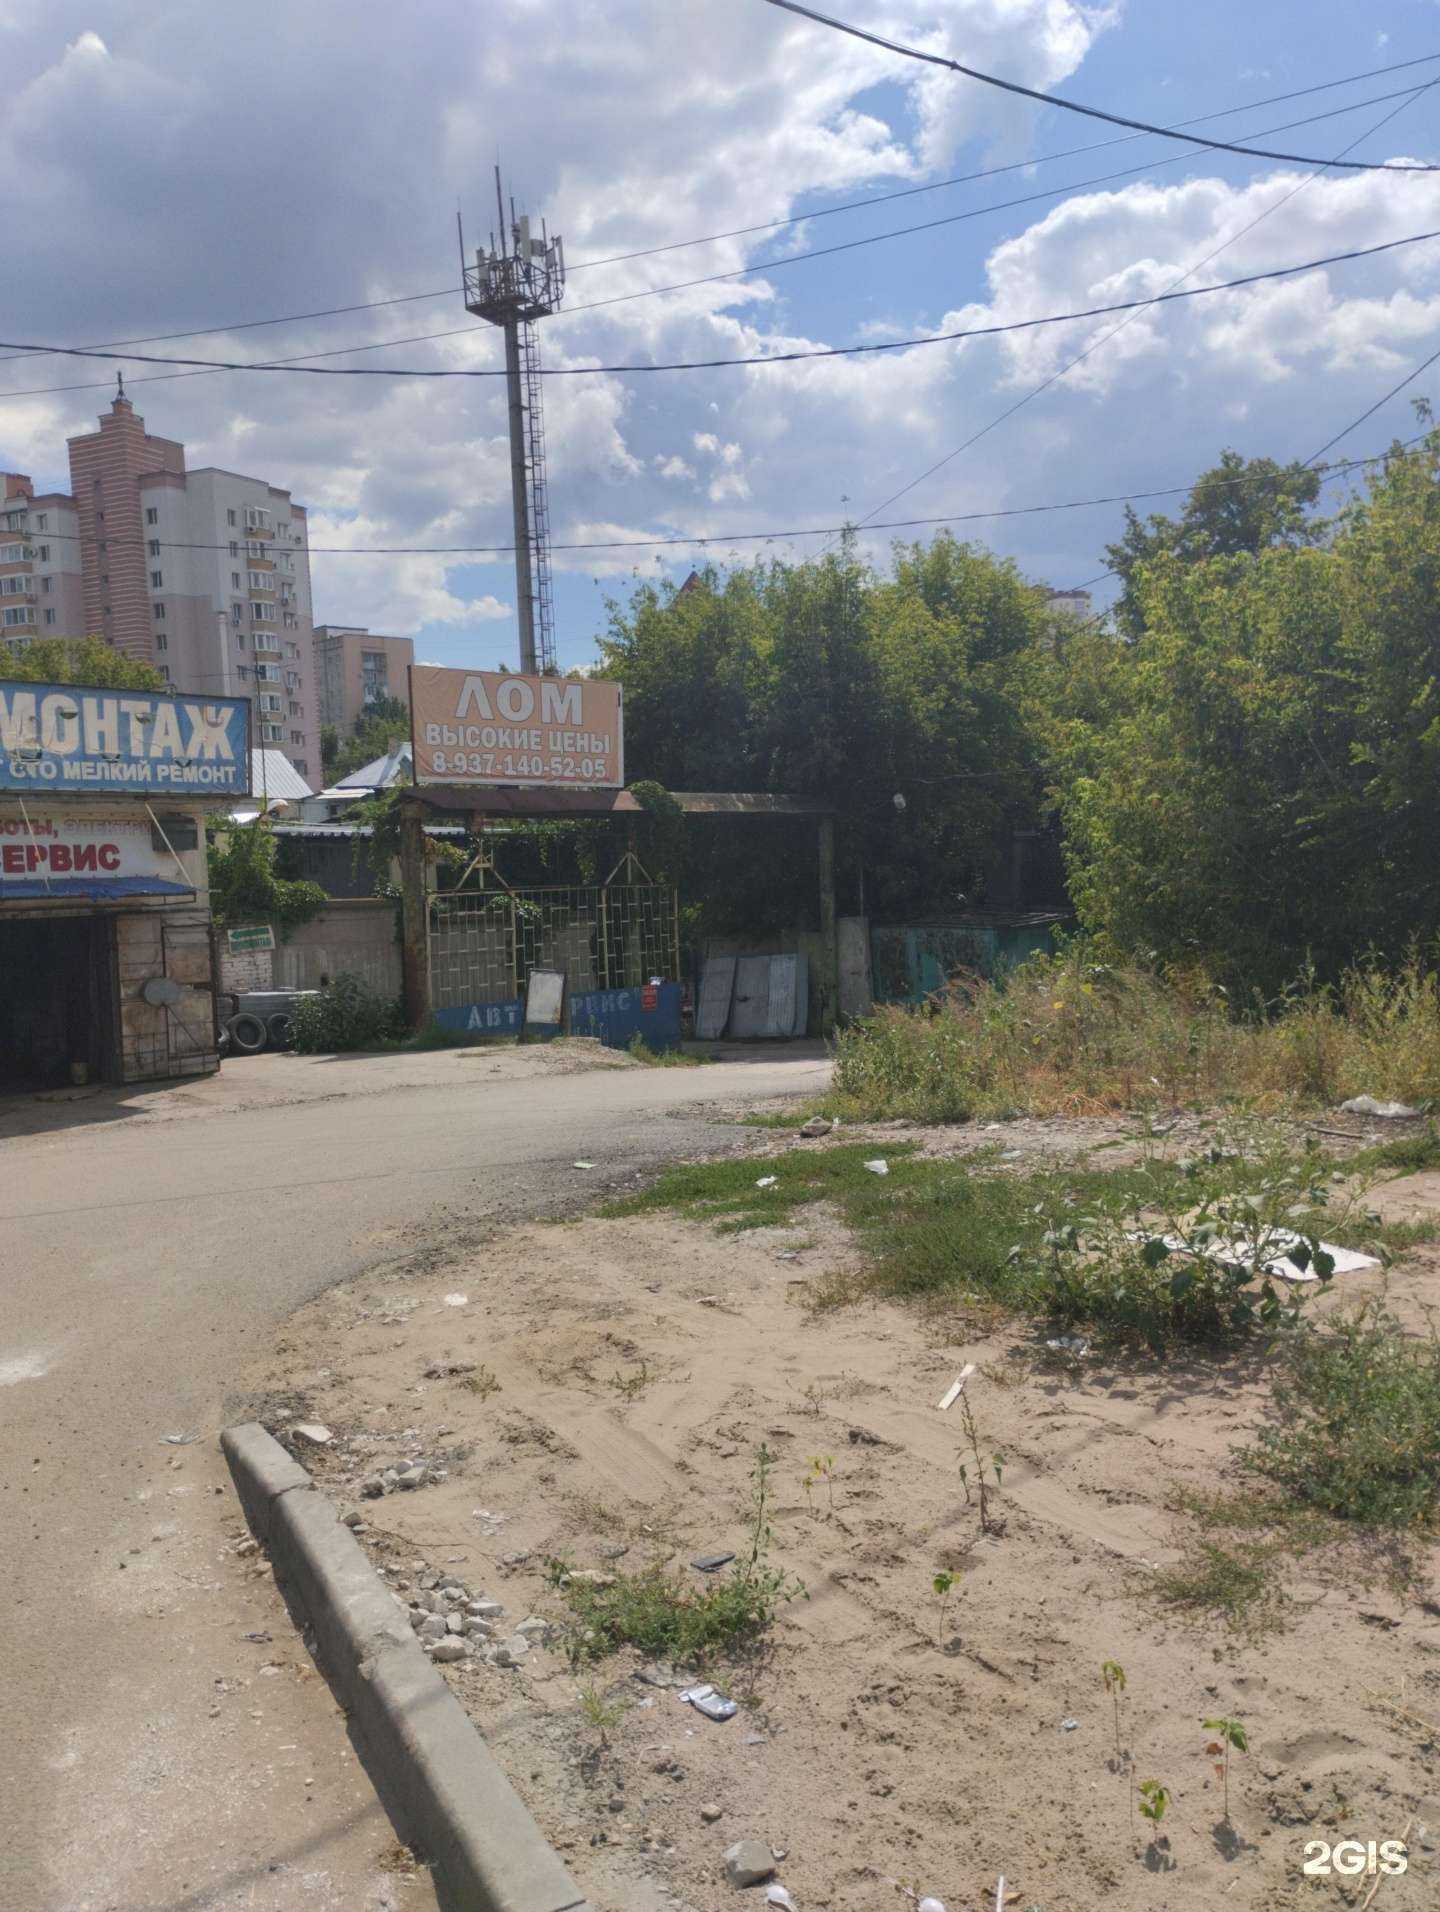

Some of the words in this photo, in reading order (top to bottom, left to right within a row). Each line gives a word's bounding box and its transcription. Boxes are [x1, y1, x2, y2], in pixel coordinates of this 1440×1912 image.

[455, 676, 583, 726] ЛОМ
[426, 723, 544, 750] ВЫСОКИЕ
[549, 730, 611, 755] ЦЕНЫ
[9, 760, 57, 780] СТО
[63, 760, 152, 782] МЕЛКИЙ
[157, 764, 236, 784] РЕМОНТ
[432, 751, 606, 778] 8-937-140-52-05
[0, 843, 121, 873] ЕРВИС
